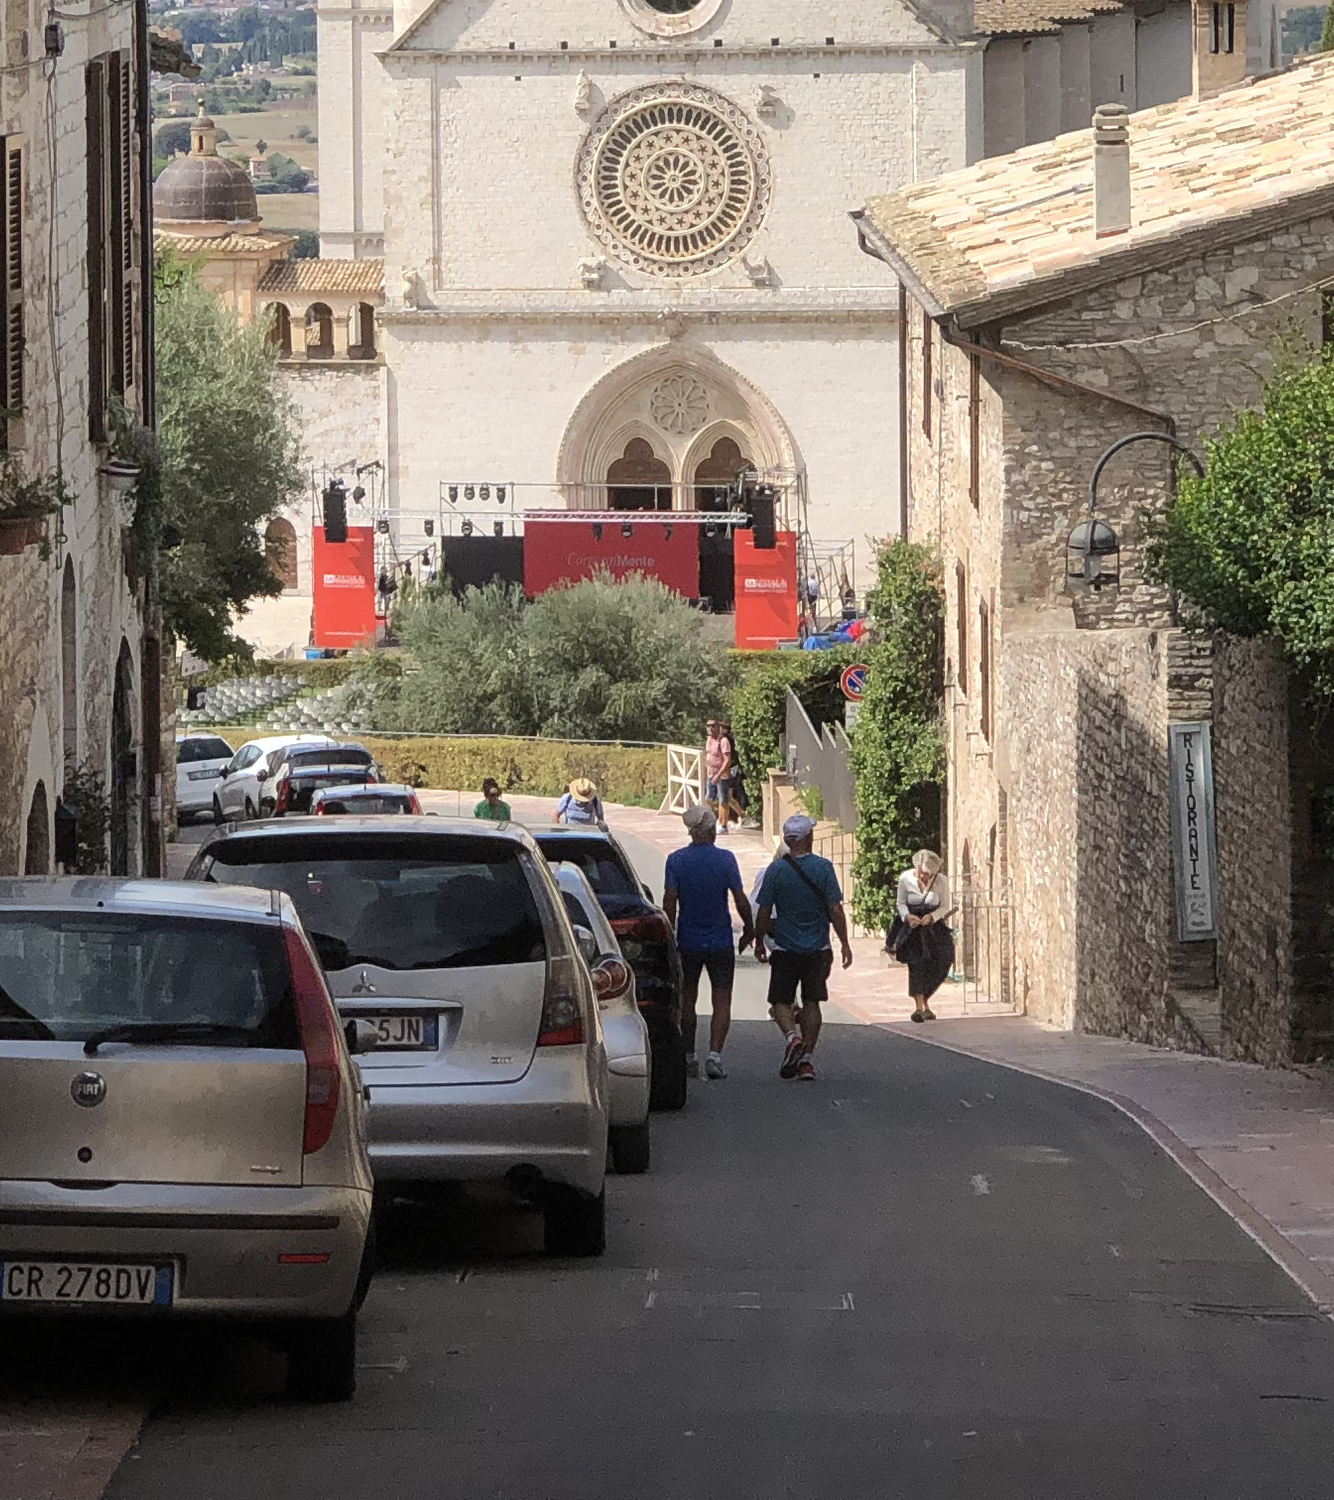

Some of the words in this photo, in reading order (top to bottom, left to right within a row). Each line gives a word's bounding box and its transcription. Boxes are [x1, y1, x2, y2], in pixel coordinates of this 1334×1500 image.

[1183, 732, 1201, 890] RISTORANTE
[368, 1018, 420, 1043] 5JN
[77, 1083, 100, 1095] FIAT
[8, 1266, 44, 1297] CR
[55, 1267, 152, 1300] 278DV
